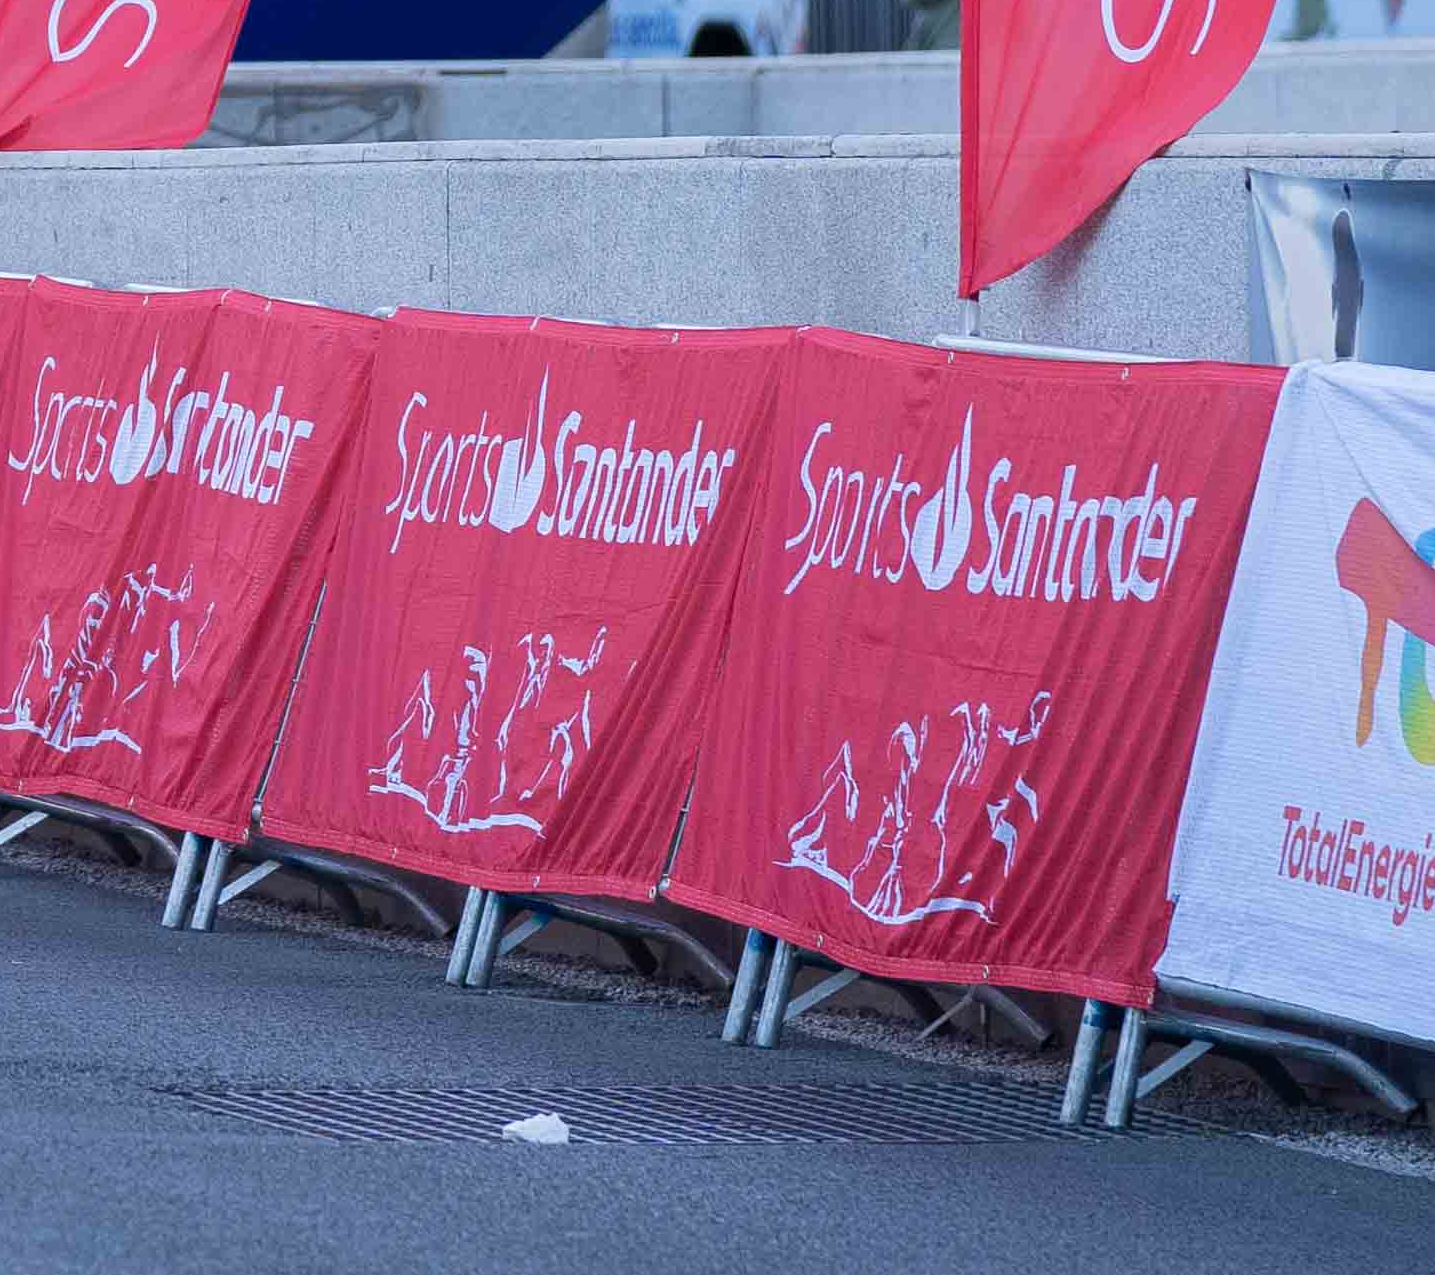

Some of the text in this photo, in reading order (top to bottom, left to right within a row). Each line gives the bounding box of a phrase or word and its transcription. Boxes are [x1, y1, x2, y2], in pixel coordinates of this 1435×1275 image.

[385, 391, 736, 554] Sports Santander
[784, 422, 1197, 603] Sports Santander
